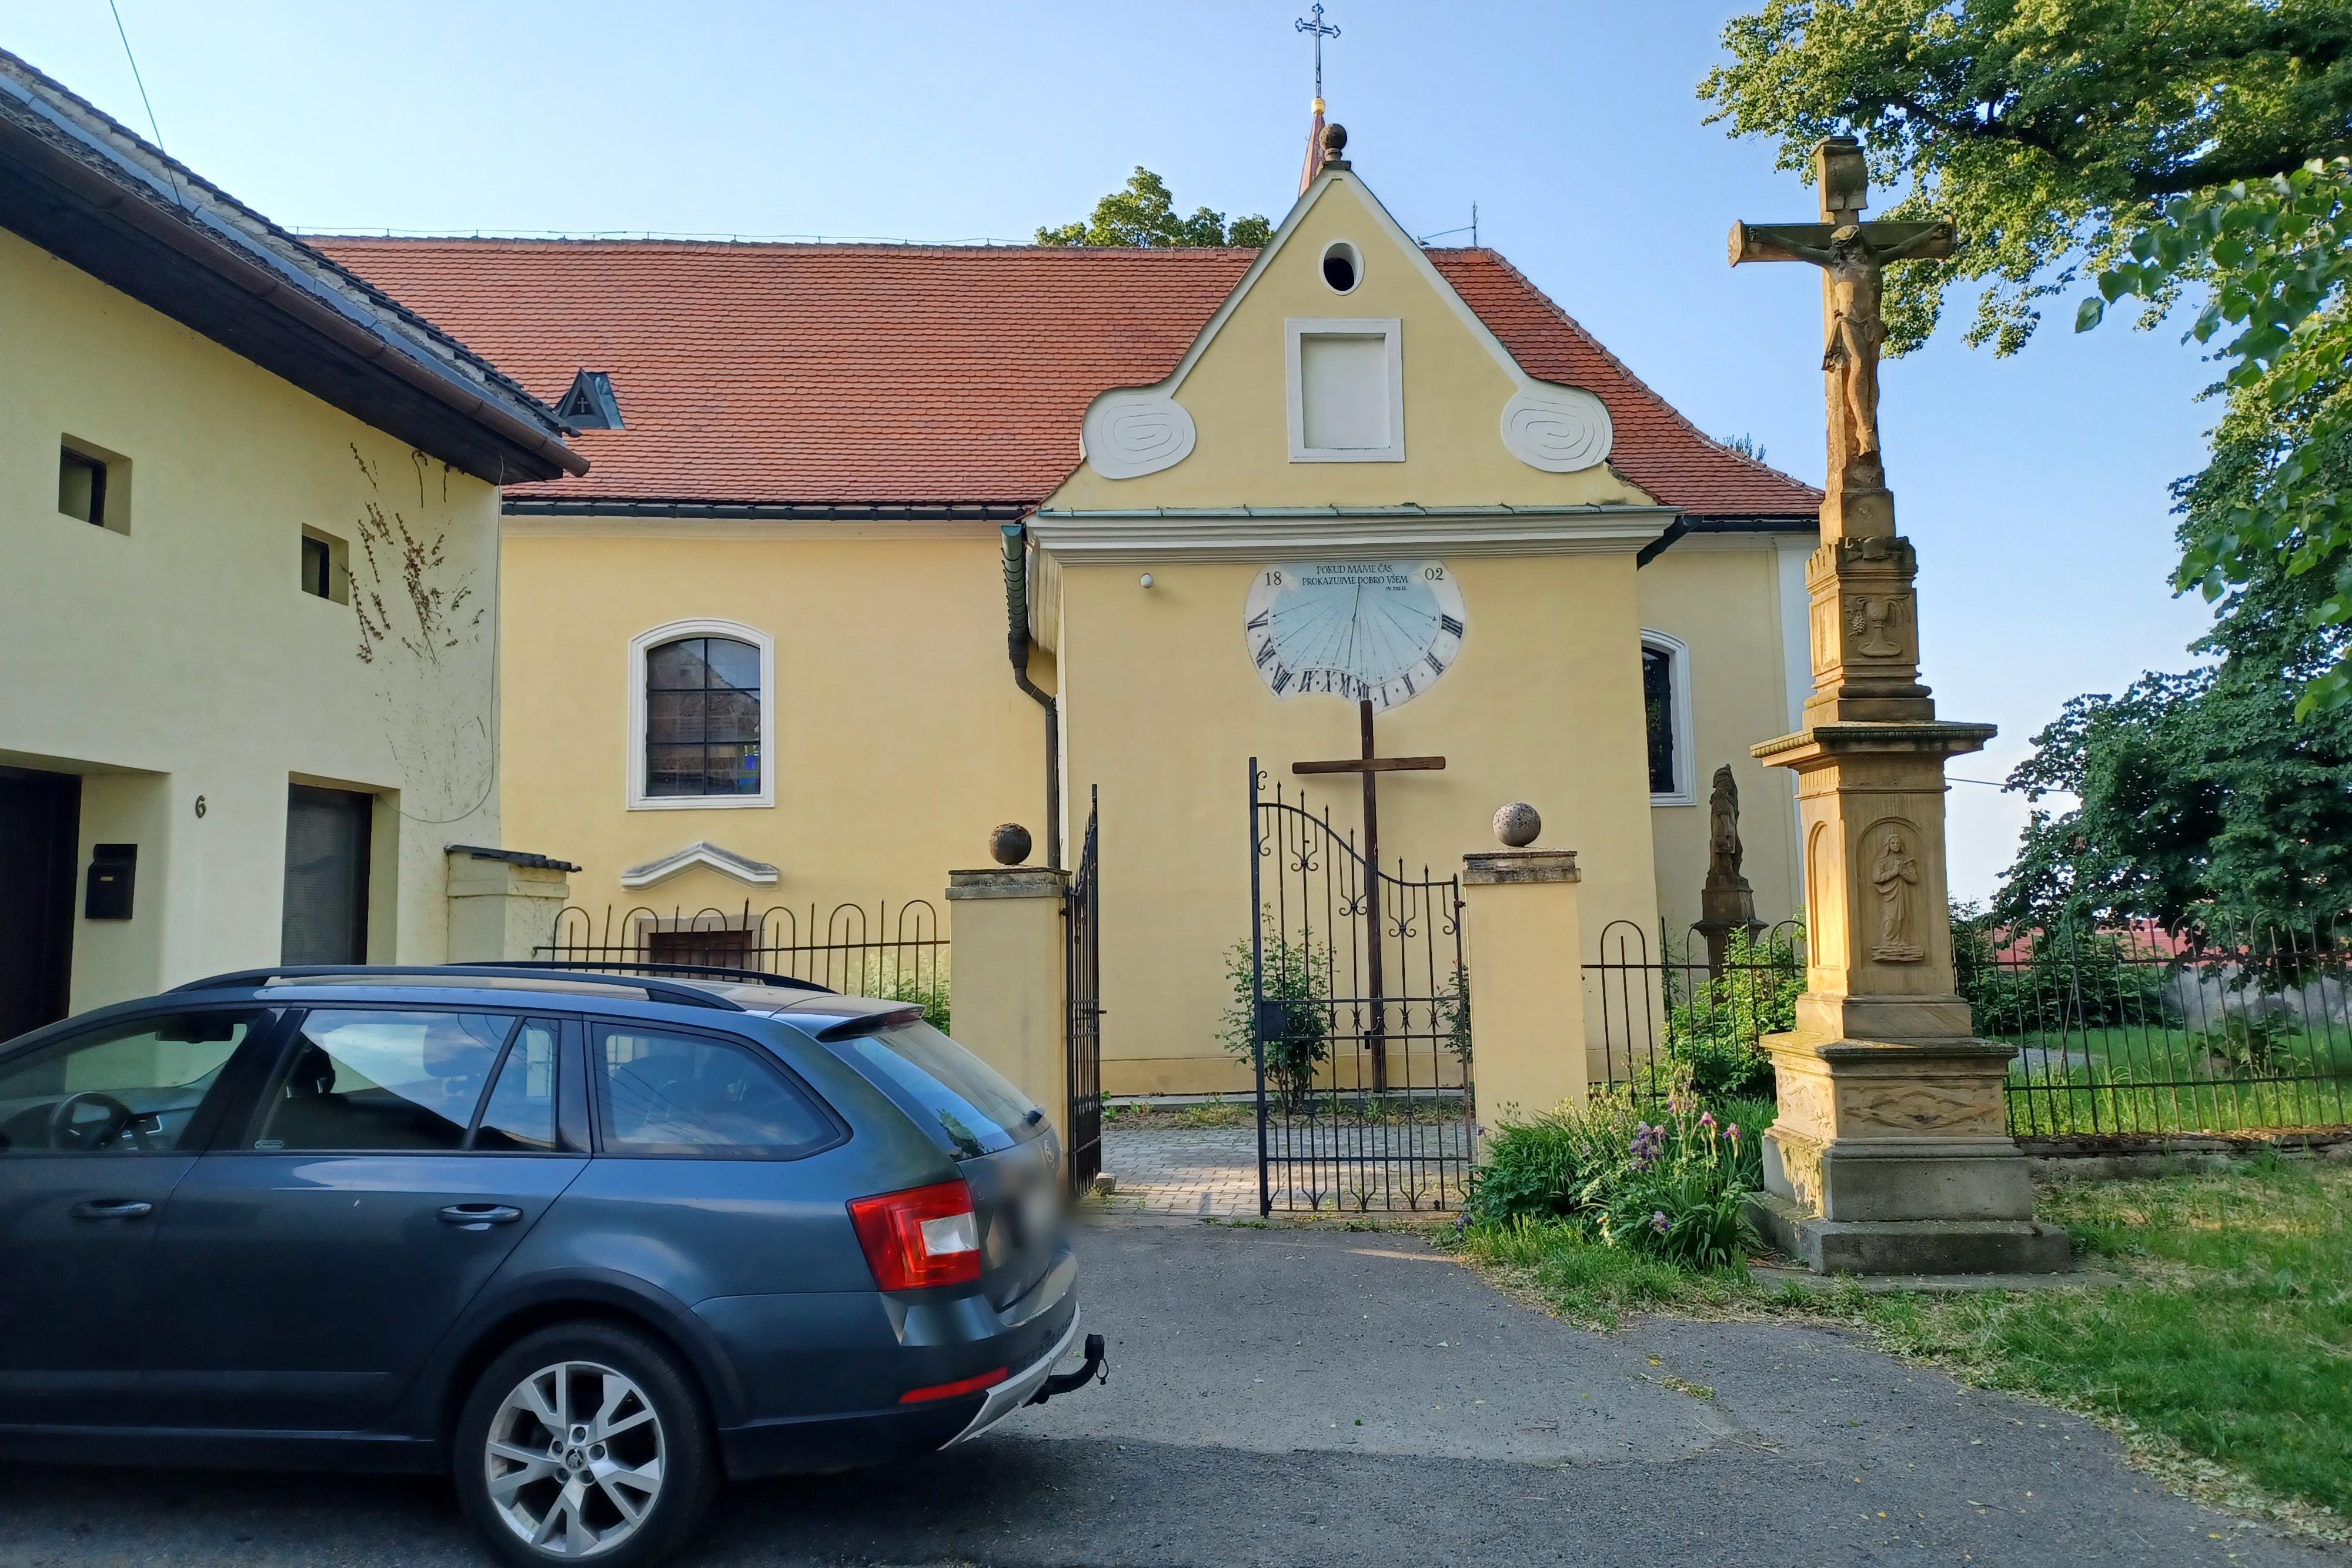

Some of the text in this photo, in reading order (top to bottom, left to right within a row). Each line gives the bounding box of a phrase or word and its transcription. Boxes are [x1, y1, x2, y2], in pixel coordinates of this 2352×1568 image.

[1317, 565, 1346, 574] POKUD
[1347, 563, 1377, 574] MÁME
[1425, 567, 1444, 580] 02
[1265, 571, 1282, 586] 18
[1302, 573, 1409, 586] PROKAZUJME DOBRO VŠEM
[195, 795, 206, 818] 6
